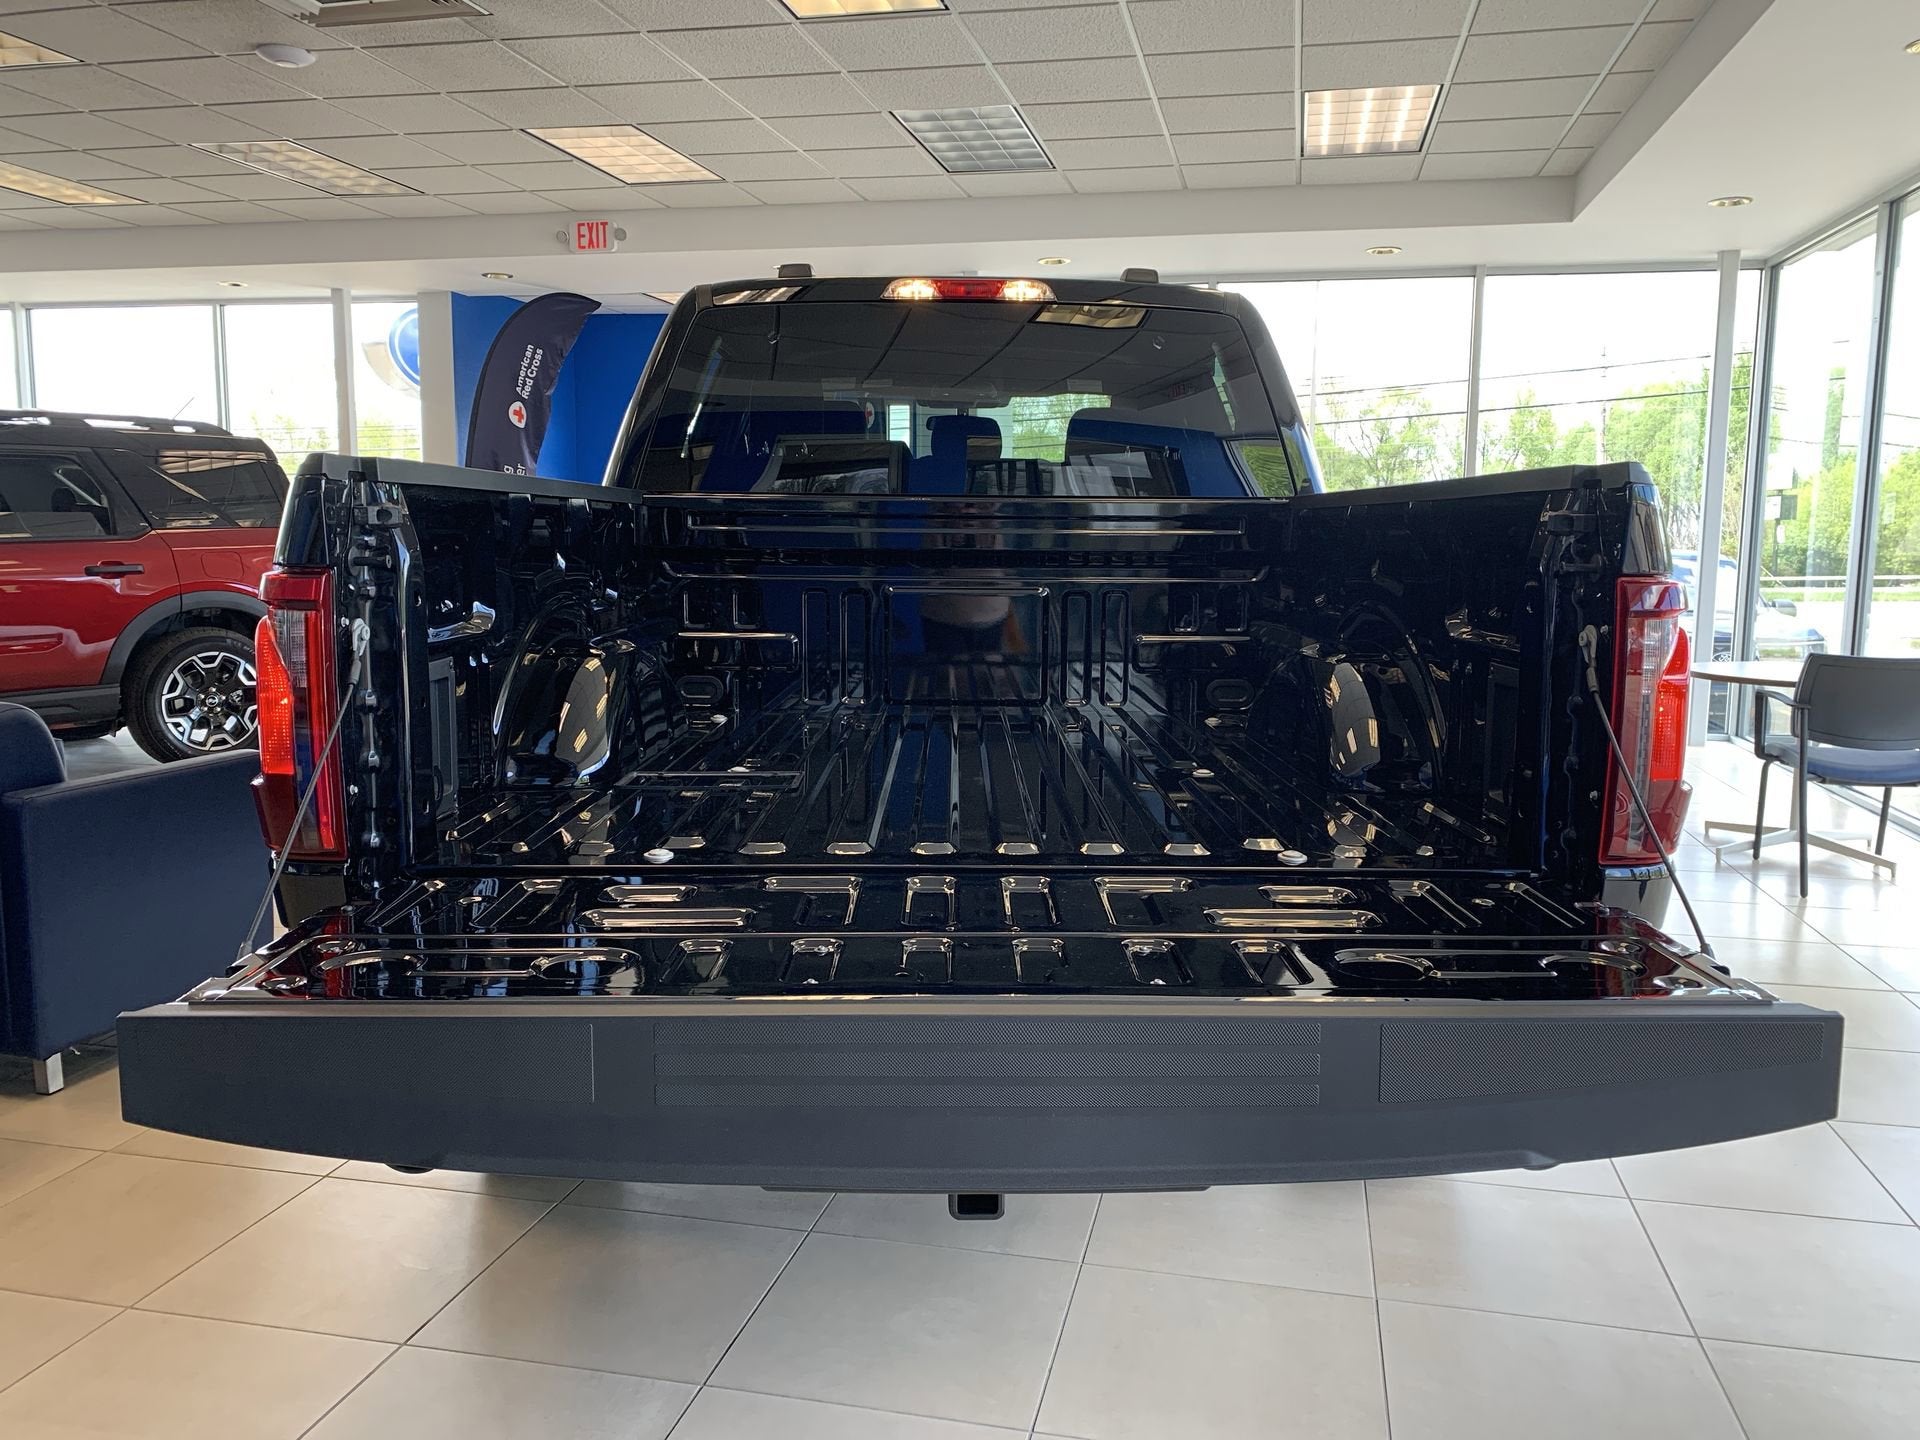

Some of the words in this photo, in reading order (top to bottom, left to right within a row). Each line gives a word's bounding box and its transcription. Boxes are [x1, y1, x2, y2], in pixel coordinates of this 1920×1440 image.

[577, 221, 609, 250] EXIT
[515, 344, 534, 396] American
[527, 348, 544, 378] Cross
[521, 377, 534, 399] Red
